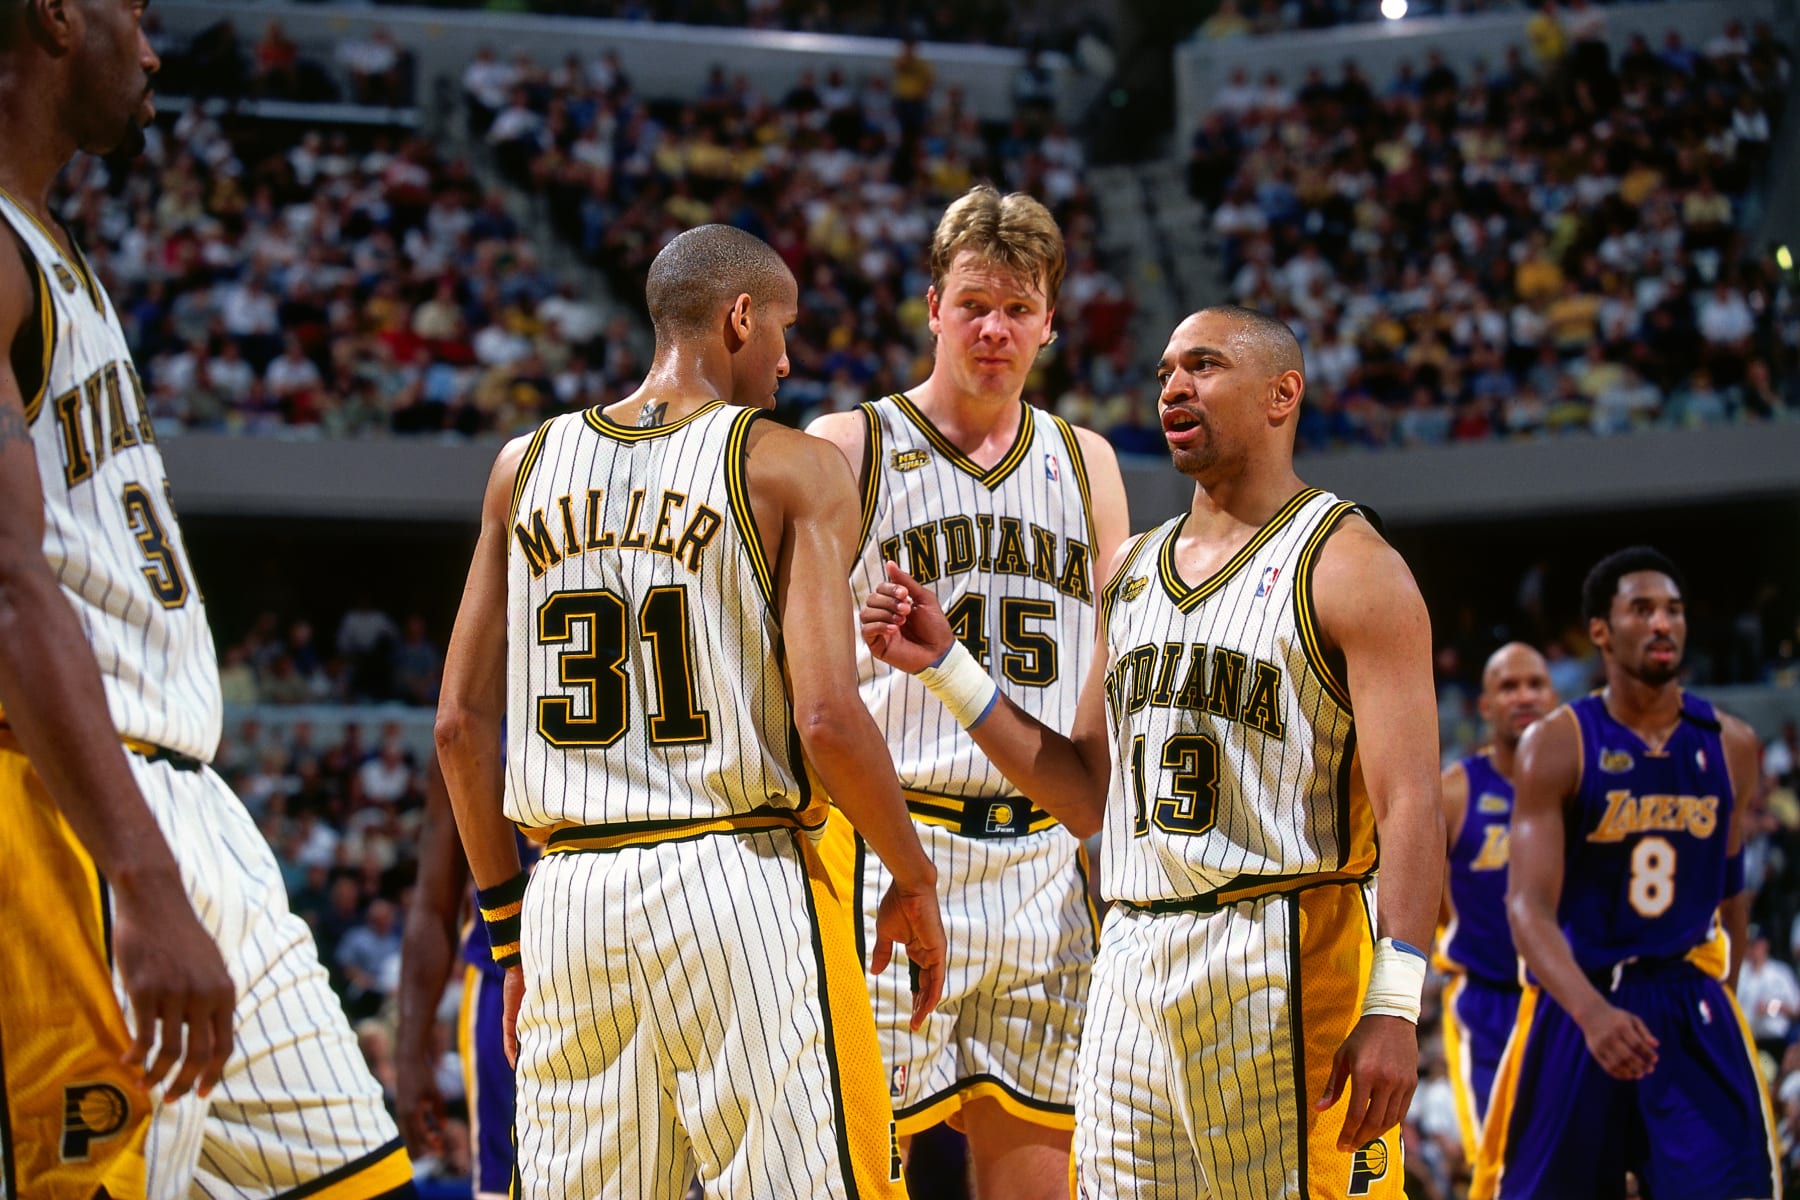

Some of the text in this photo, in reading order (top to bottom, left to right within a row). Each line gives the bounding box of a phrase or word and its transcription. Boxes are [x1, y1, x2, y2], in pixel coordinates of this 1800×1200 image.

[514, 489, 723, 581] MILLER
[881, 514, 1093, 607] INDIANA
[536, 584, 712, 749] 31
[946, 592, 1058, 688] 45
[1104, 642, 1285, 742] INDIANA
[1131, 733, 1220, 838] 13
[1586, 789, 1720, 840] LAKERS
[1628, 836, 1677, 918] 8
